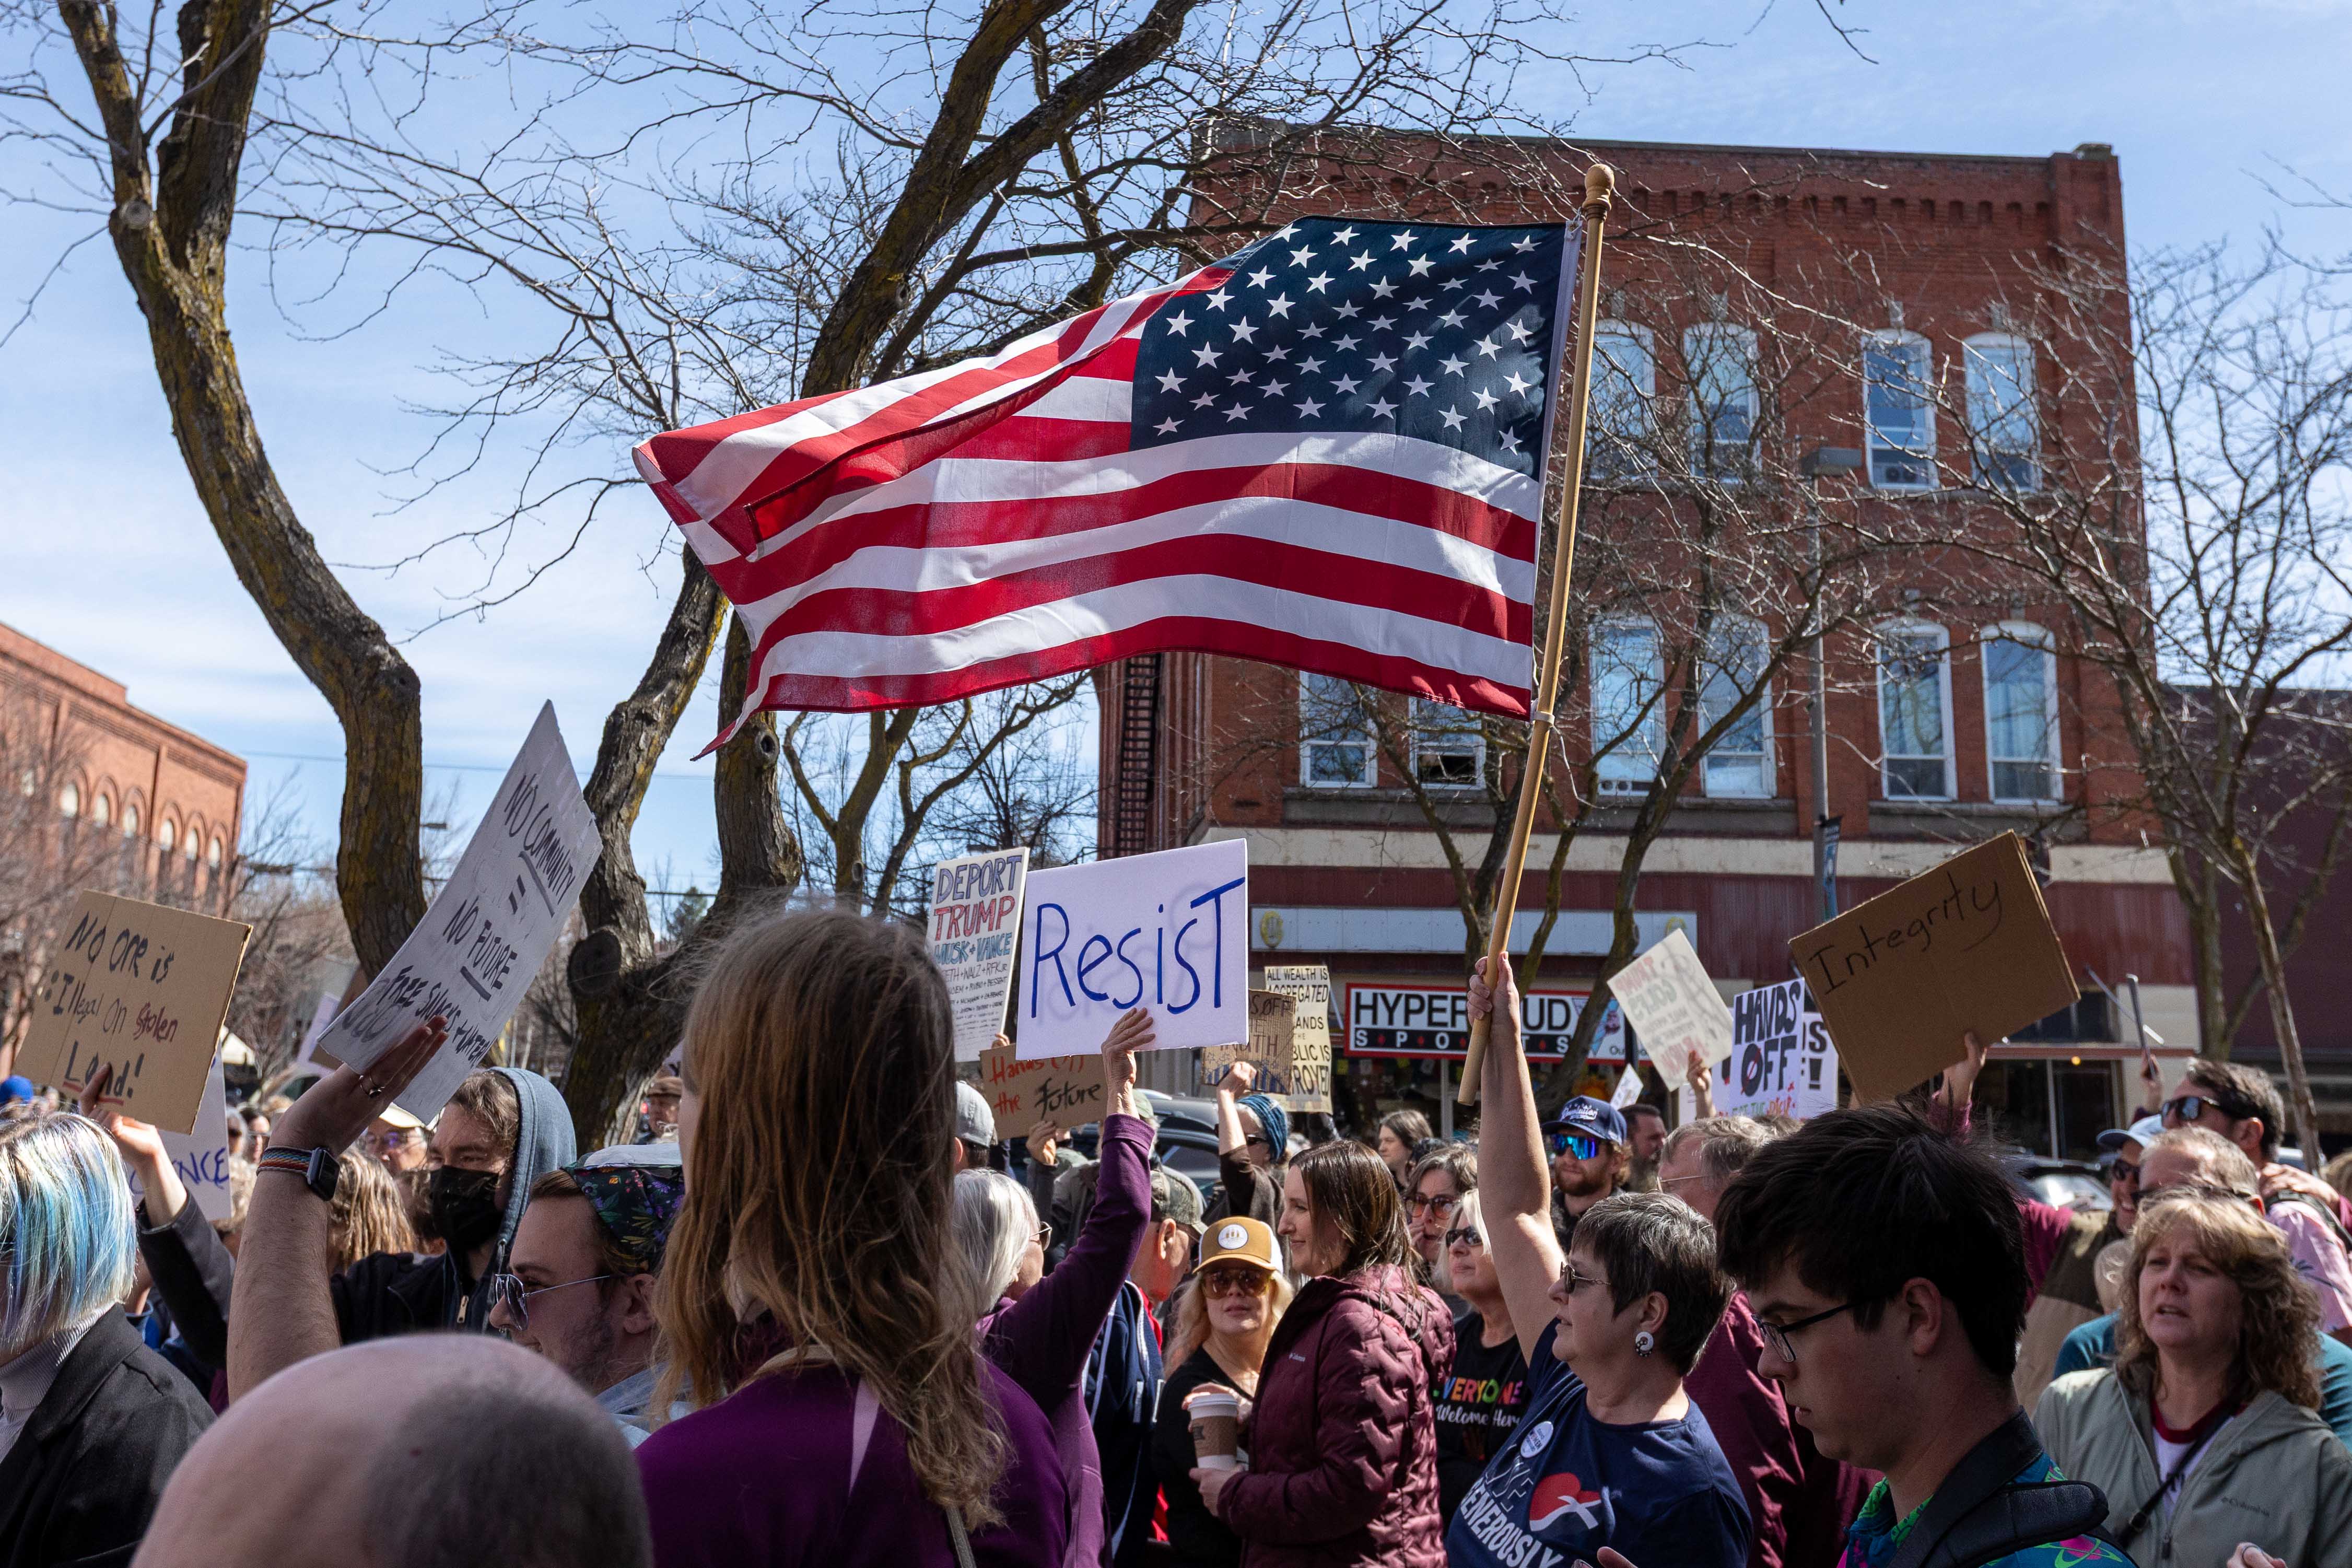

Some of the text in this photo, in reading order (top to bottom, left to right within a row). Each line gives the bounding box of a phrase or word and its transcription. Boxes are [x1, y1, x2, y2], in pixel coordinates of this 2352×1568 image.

[504, 773, 575, 905] NO COMMUNITY
[936, 855, 1022, 904] DEPORT
[934, 895, 1015, 941] TRUMP
[1808, 871, 2003, 995] Integrity
[65, 911, 107, 964] No
[150, 945, 175, 985] is
[442, 895, 518, 990] NO FUTURE
[934, 940, 970, 965] MUSK
[976, 932, 1012, 962] VANCE
[376, 965, 429, 1008] FREE
[1267, 967, 1328, 981] ALL WEALTH IS
[1295, 1016, 1324, 1029] ANDS
[1735, 981, 1801, 1045] HANDS
[1293, 1044, 1331, 1062] BLIC IS
[993, 1076, 1101, 1120] the Future
[1292, 1065, 1329, 1096] ROYED
[1433, 1376, 1523, 1405] VERYONE
[1436, 1404, 1488, 1426] Welcome
